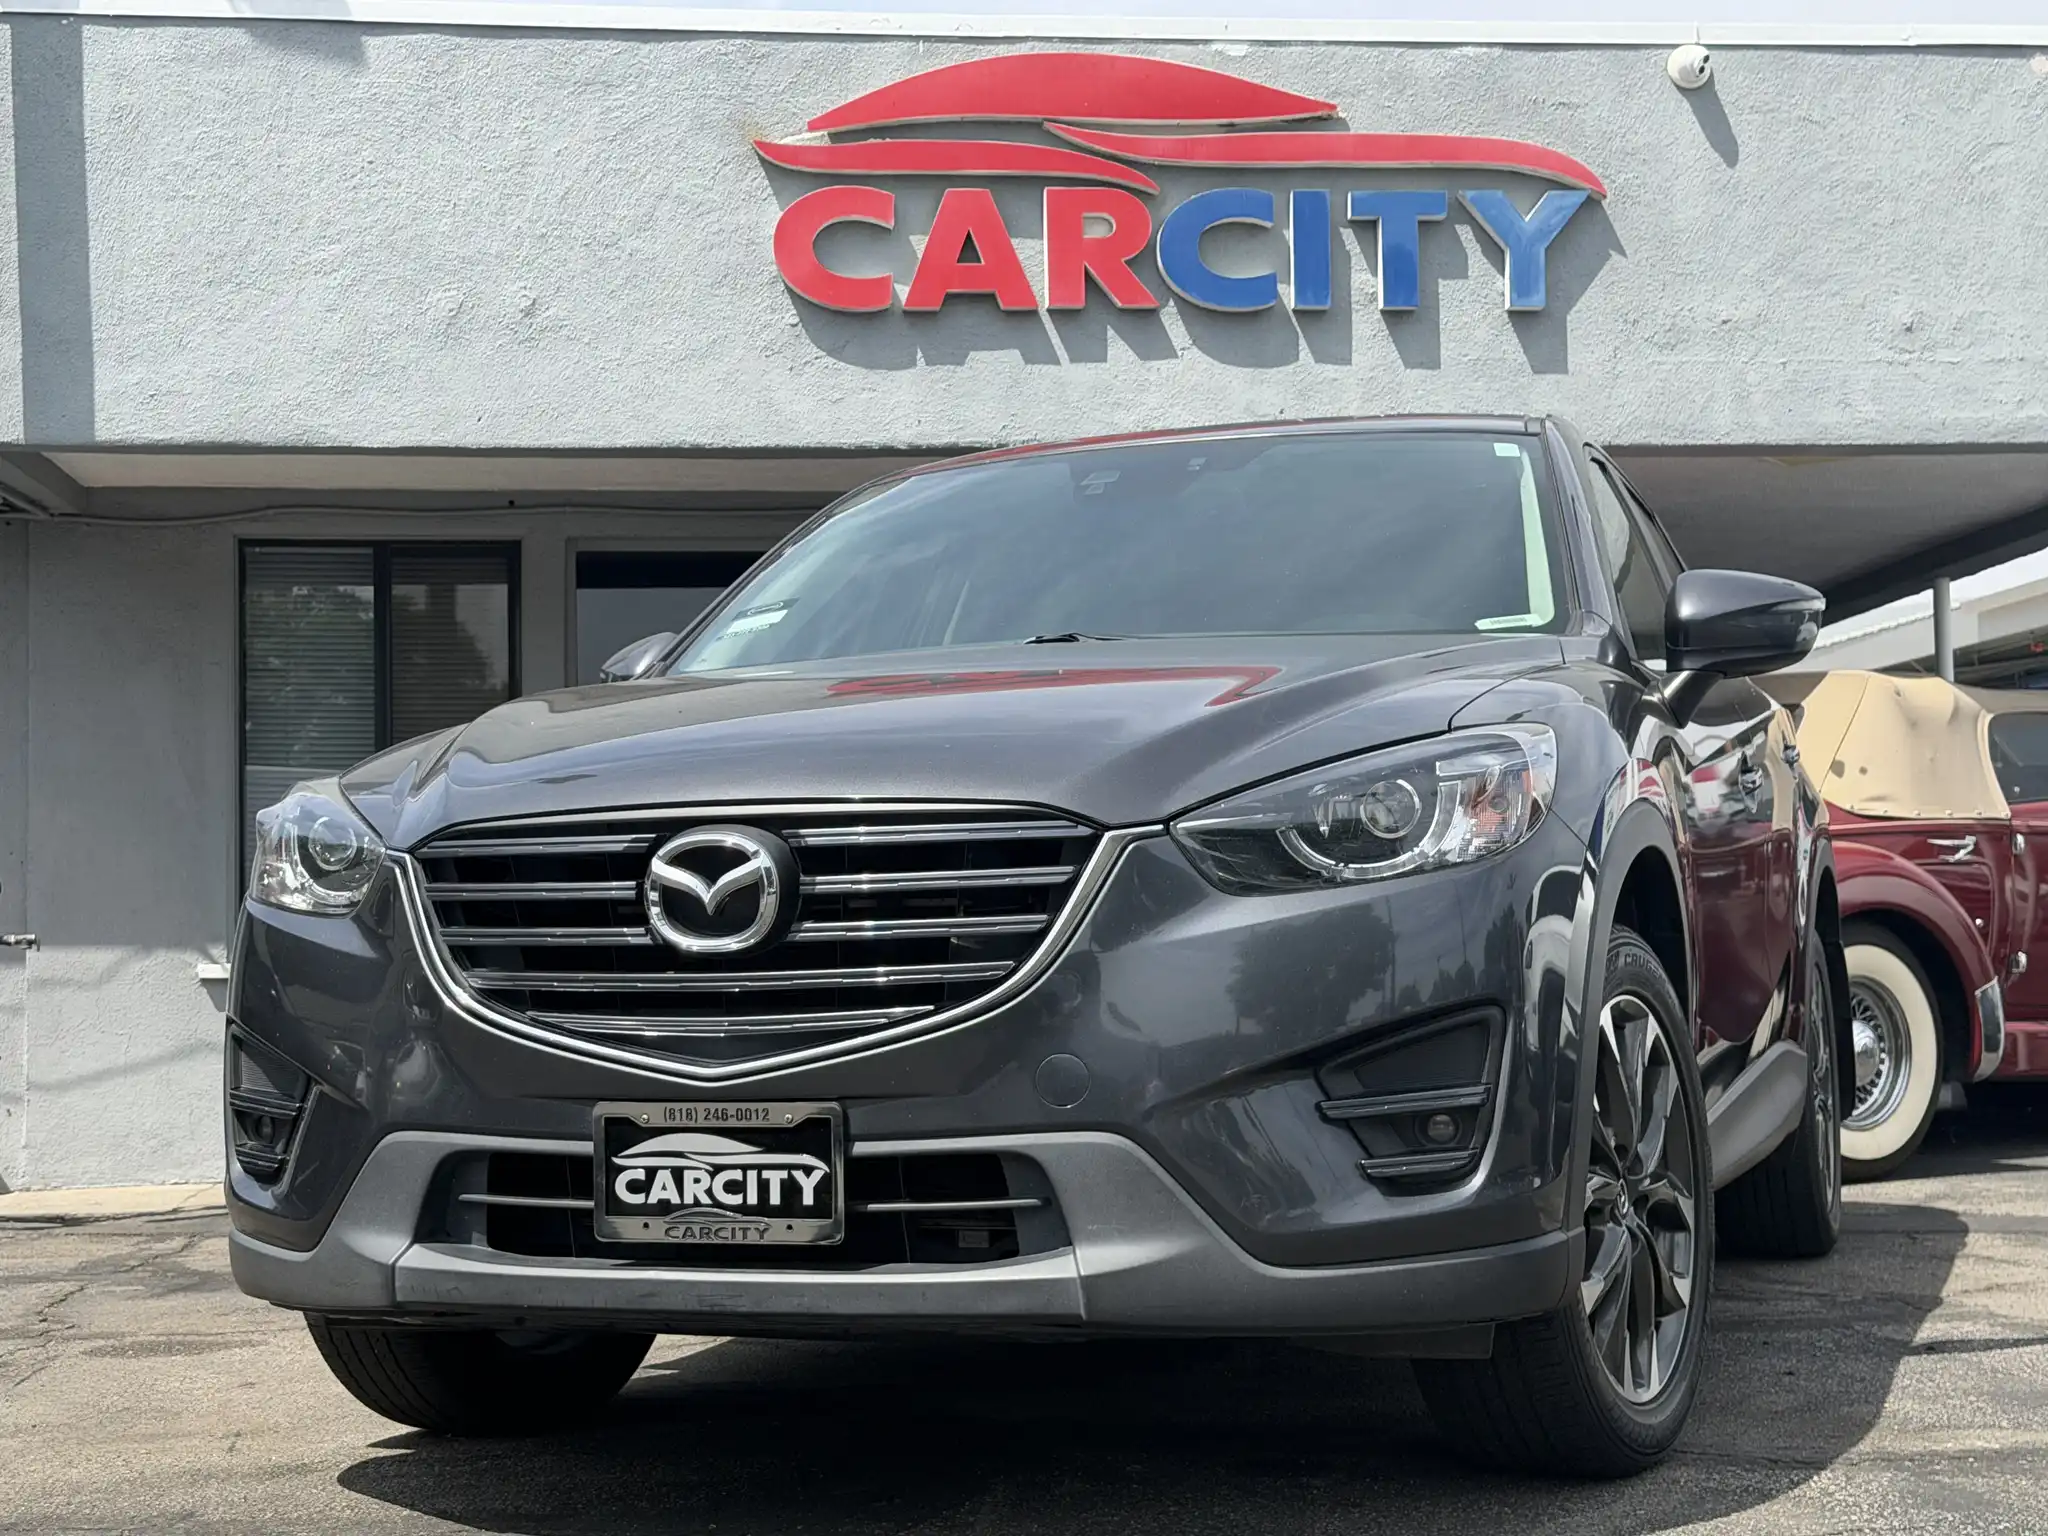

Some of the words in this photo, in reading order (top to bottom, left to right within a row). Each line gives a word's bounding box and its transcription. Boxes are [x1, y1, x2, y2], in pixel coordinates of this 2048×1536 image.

[773, 184, 1591, 312] CARCITY
[664, 1107, 698, 1124] (818)
[704, 1108, 770, 1123] 246-0012
[614, 1168, 825, 1206] CARCITY
[664, 1226, 770, 1242] CARCITY
